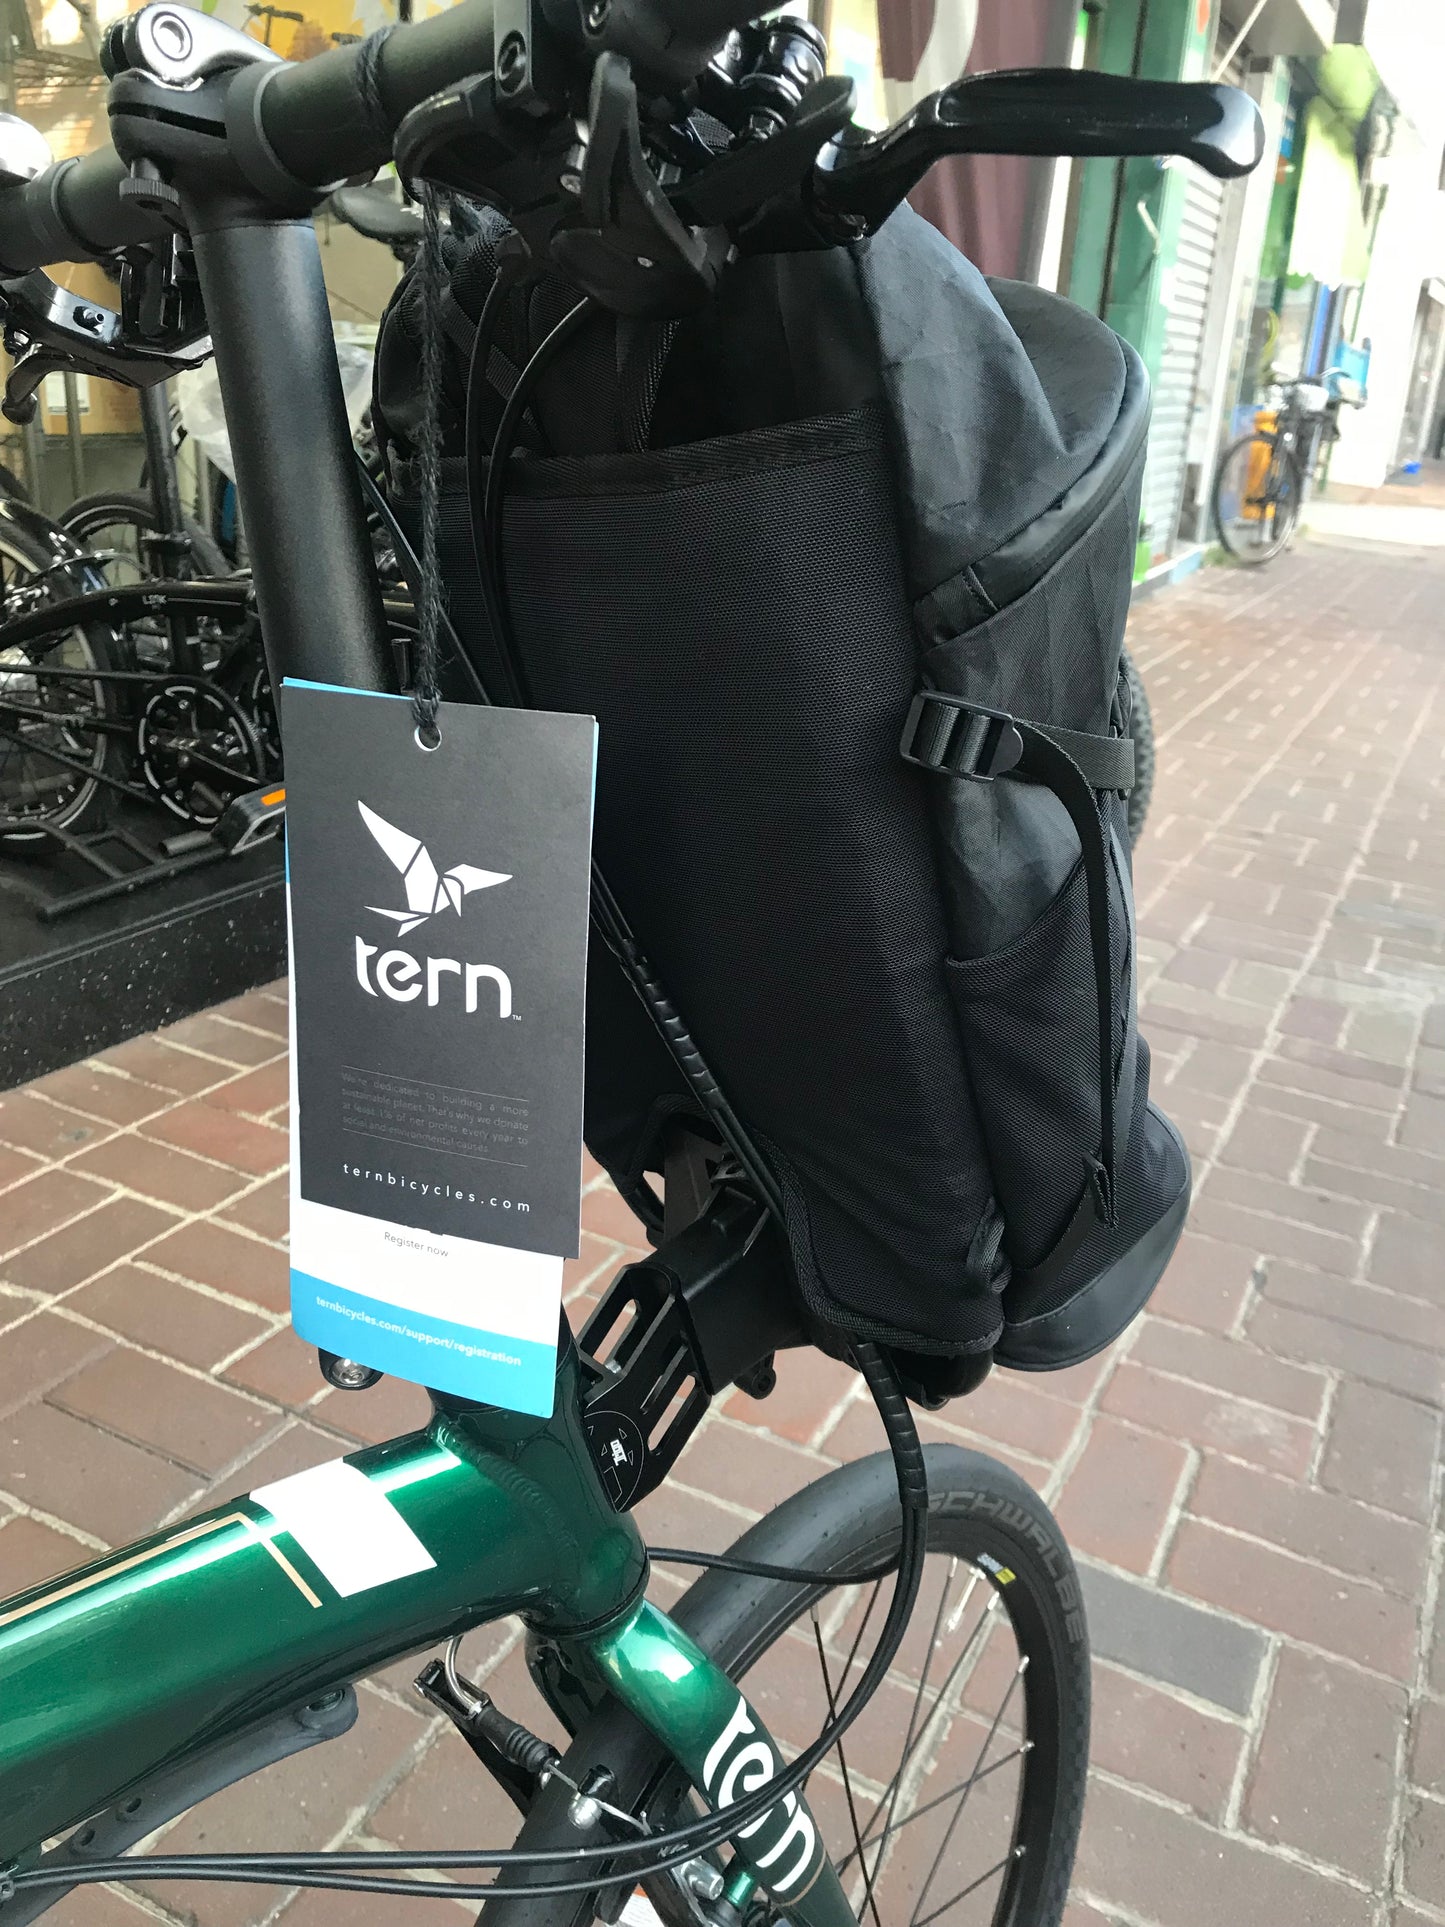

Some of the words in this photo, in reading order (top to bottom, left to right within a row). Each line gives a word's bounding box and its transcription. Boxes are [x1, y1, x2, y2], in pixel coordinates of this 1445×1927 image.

[355, 935, 512, 1019] tern
[342, 1088, 391, 1105] sustainable
[427, 1104, 454, 1118] That's
[455, 1111, 475, 1124] why
[477, 1116, 491, 1125] we
[493, 1116, 529, 1131] donate
[373, 1080, 420, 1097] dedicated
[425, 1091, 435, 1100] to
[442, 1095, 482, 1111] building
[502, 1105, 529, 1116] more
[342, 1115, 367, 1128] social
[369, 1121, 387, 1132] and
[389, 1125, 454, 1146] environmental
[396, 1112, 406, 1122] of
[409, 1116, 425, 1127] net
[428, 1119, 458, 1133] profits
[462, 1126, 489, 1139] every
[492, 1131, 514, 1143] year
[517, 1136, 529, 1145] to
[343, 1164, 530, 1212] ternbicycles.com
[384, 1231, 424, 1251] Register
[427, 1245, 449, 1257] now
[316, 1296, 522, 1366] ternbicycles.com/support/registration
[703, 1695, 815, 1892] tern
